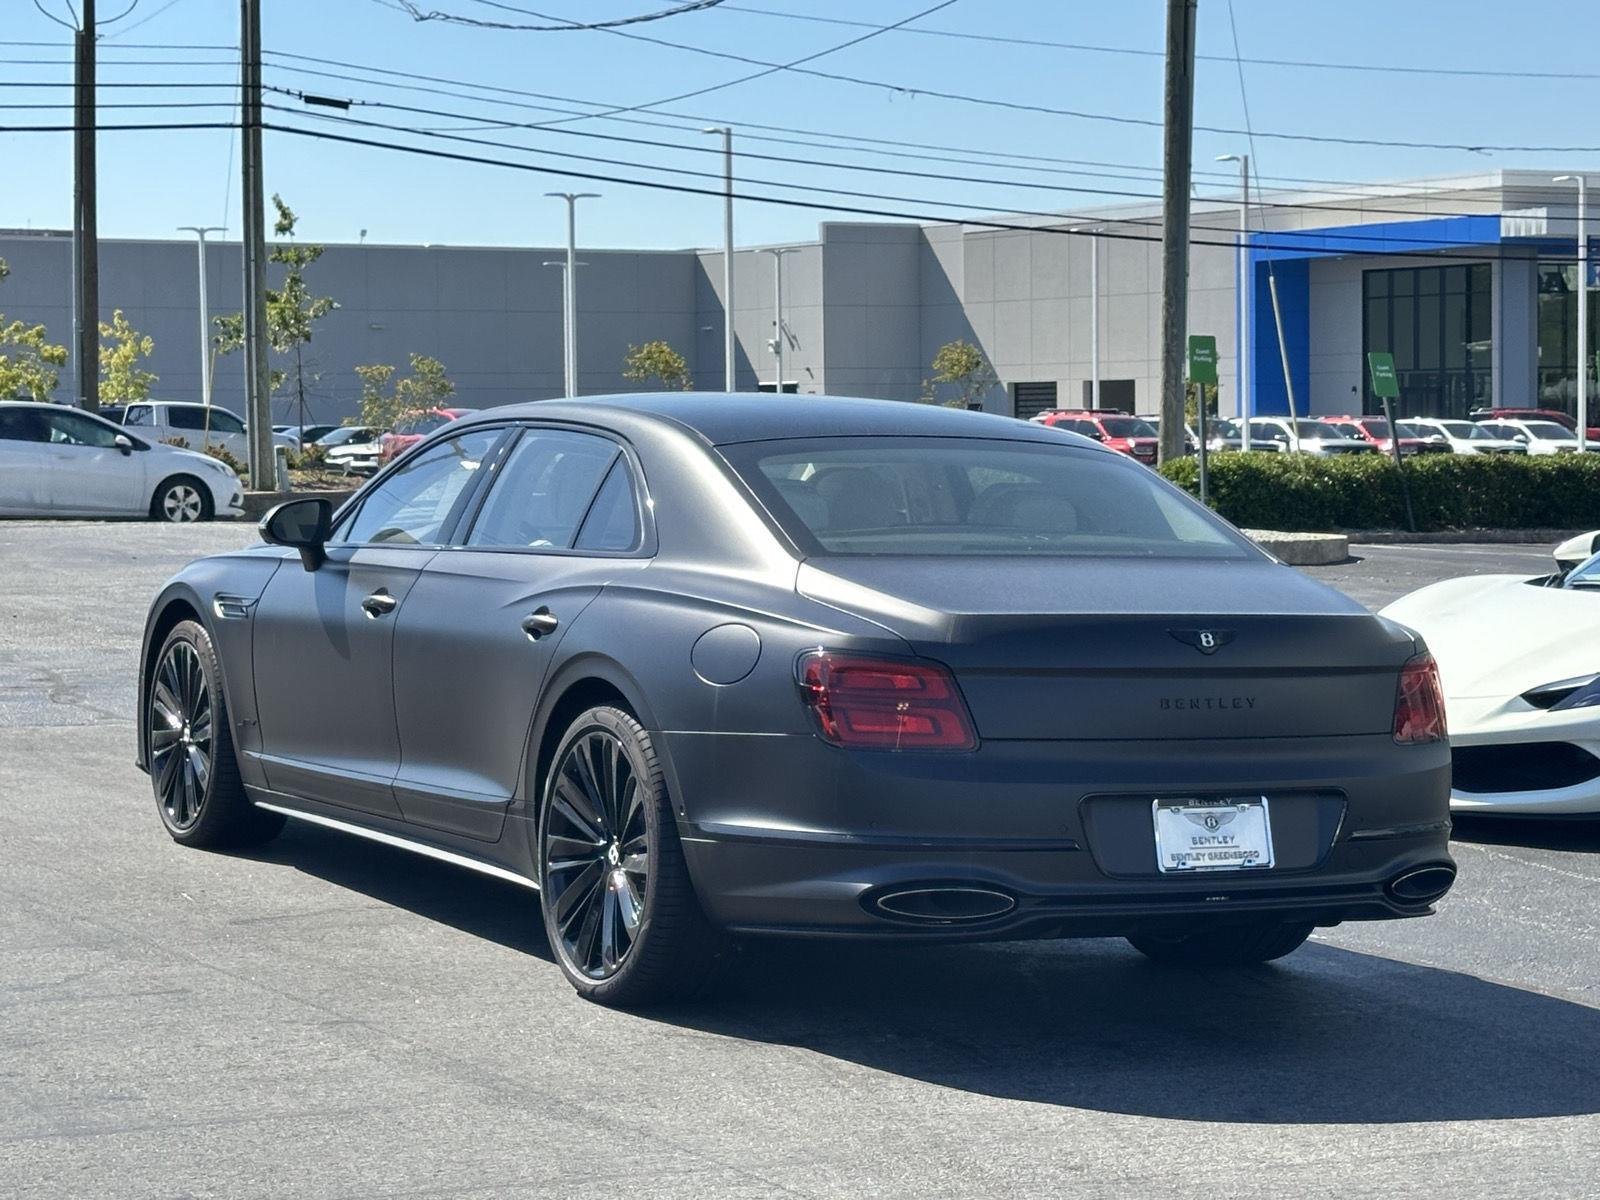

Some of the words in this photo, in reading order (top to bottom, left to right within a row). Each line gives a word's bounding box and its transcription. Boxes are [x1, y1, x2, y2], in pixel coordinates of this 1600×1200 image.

[1200, 632, 1215, 647] B
[1160, 697, 1256, 710] BENTLEY
[1191, 835, 1236, 846] BENTLEY
[1170, 852, 1206, 862] BENTLEY
[1207, 850, 1260, 861] GREENSBORO
